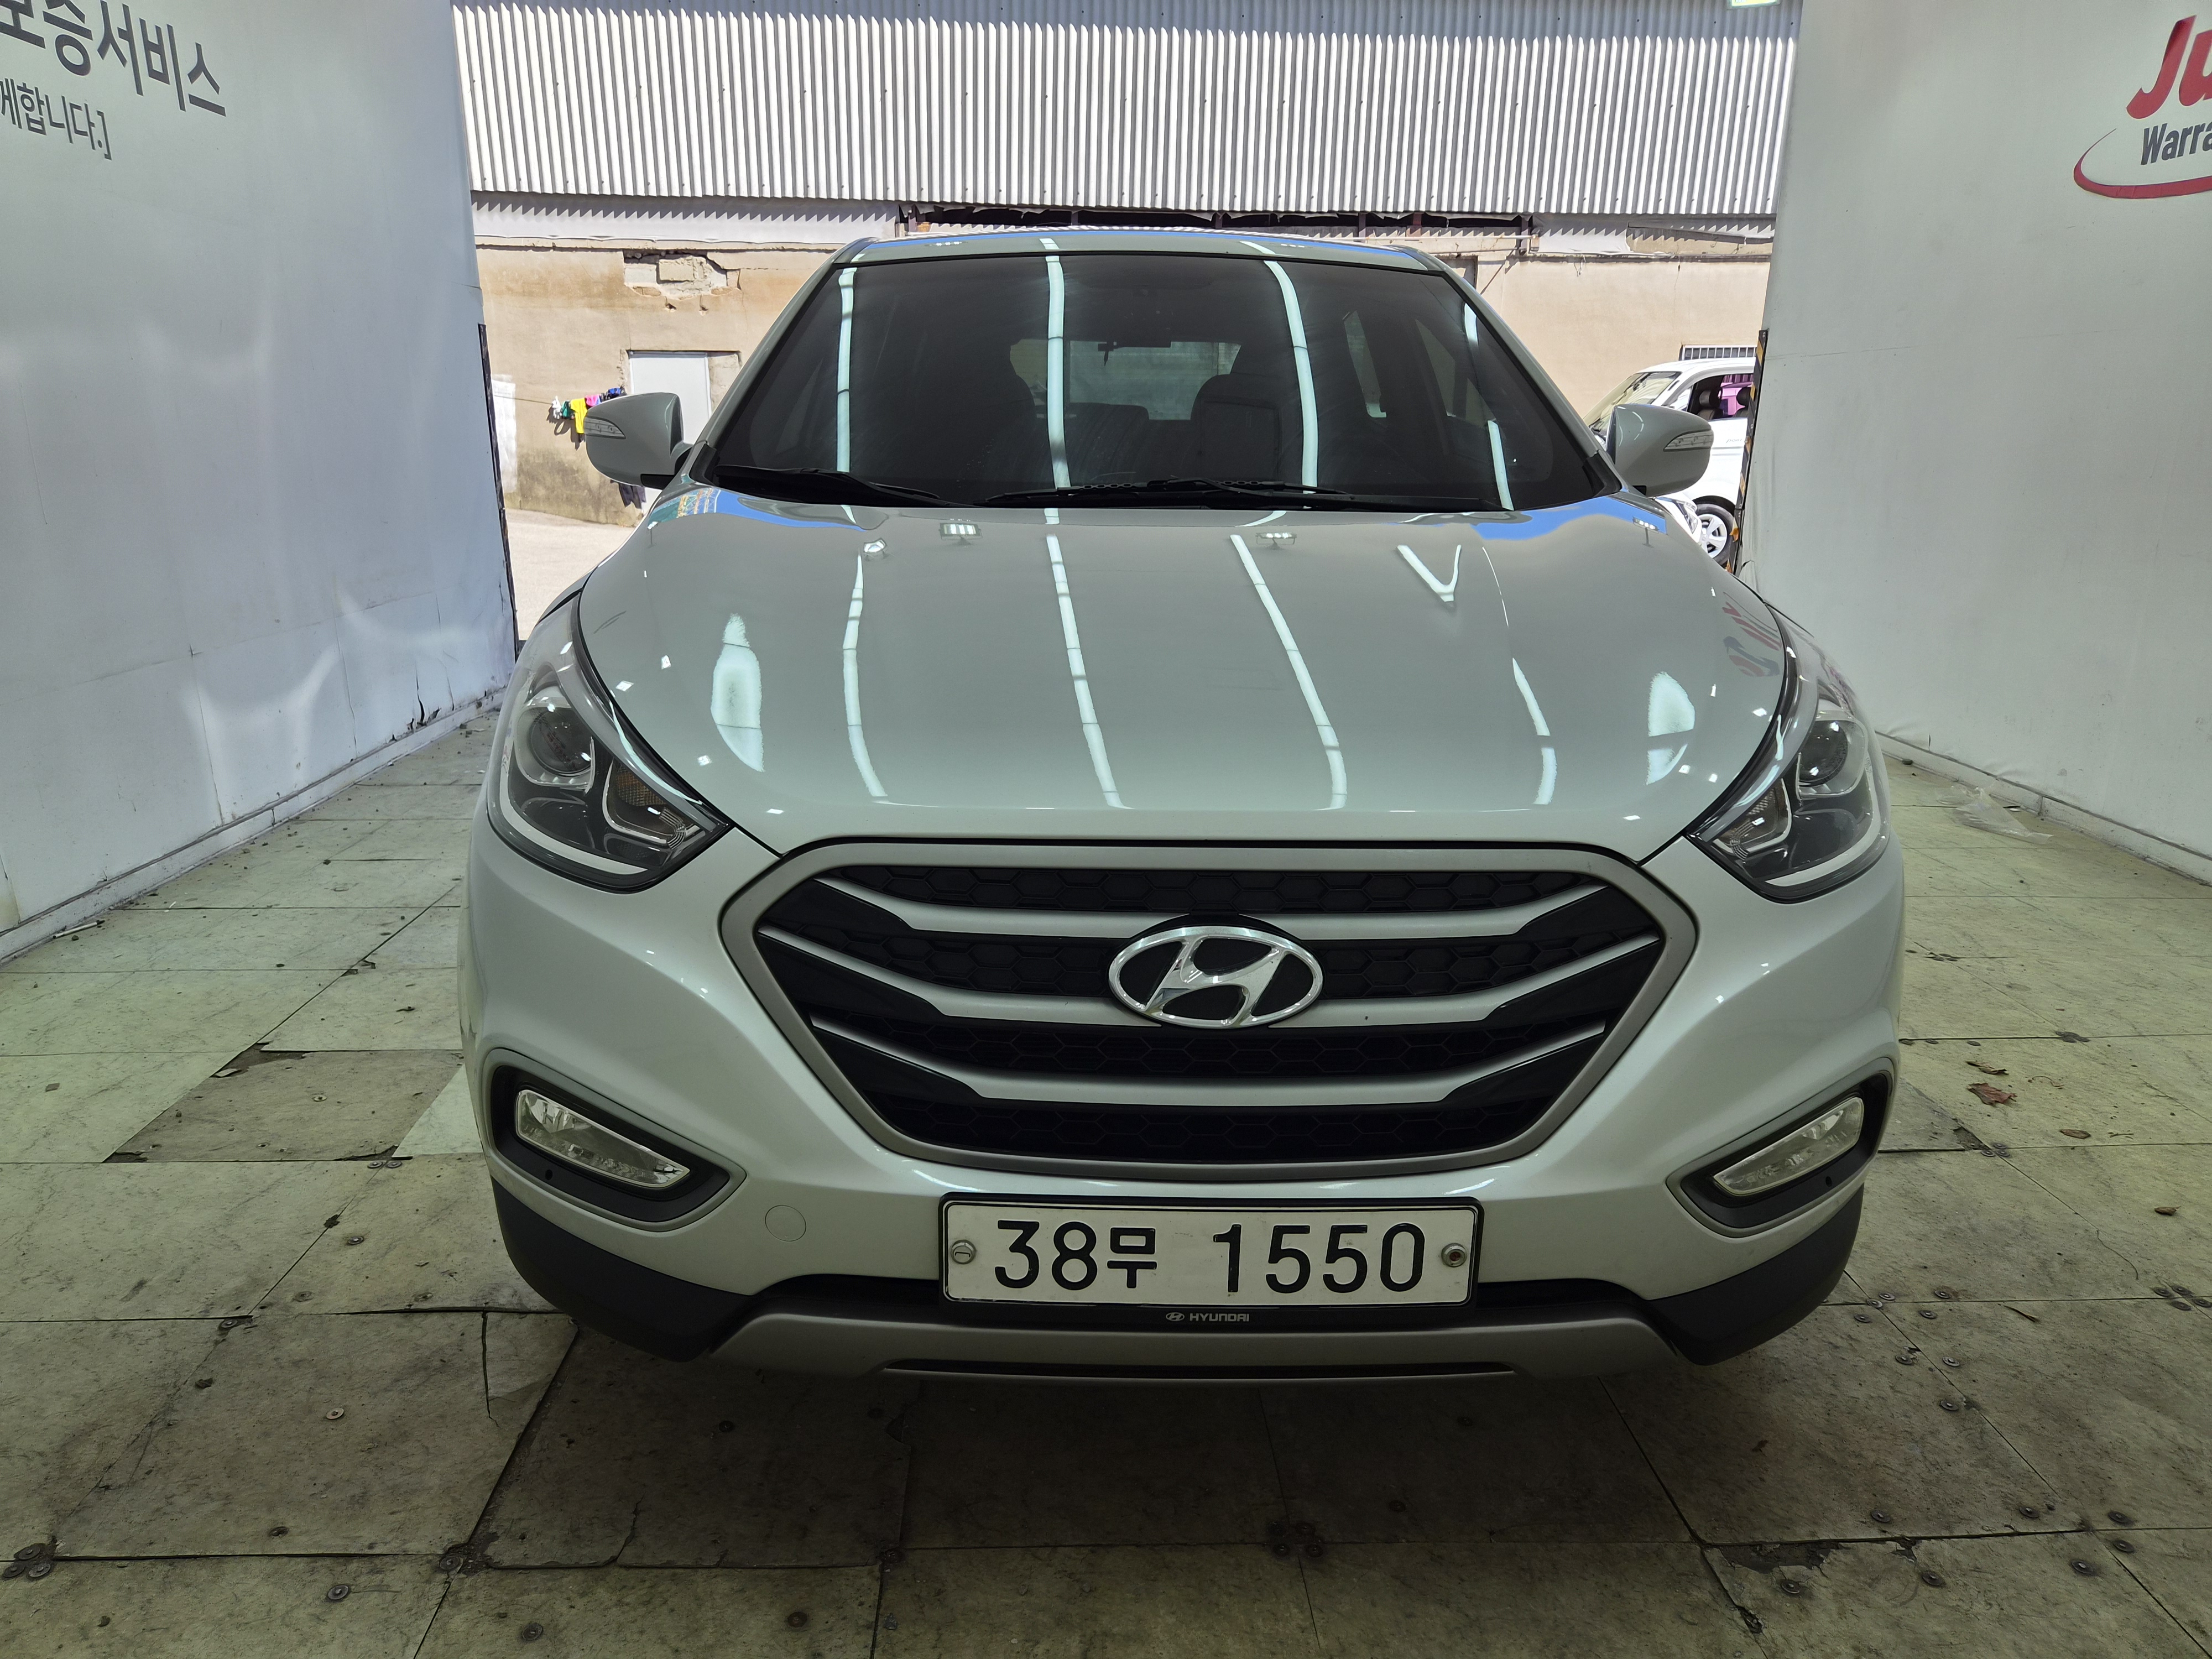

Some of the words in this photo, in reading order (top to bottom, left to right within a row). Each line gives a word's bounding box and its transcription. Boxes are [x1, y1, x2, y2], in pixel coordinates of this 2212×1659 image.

[994, 1219, 1158, 1289] 38무
[1213, 1223, 1425, 1294] 1550
[1190, 1313, 1249, 1322] HYUNDAI
